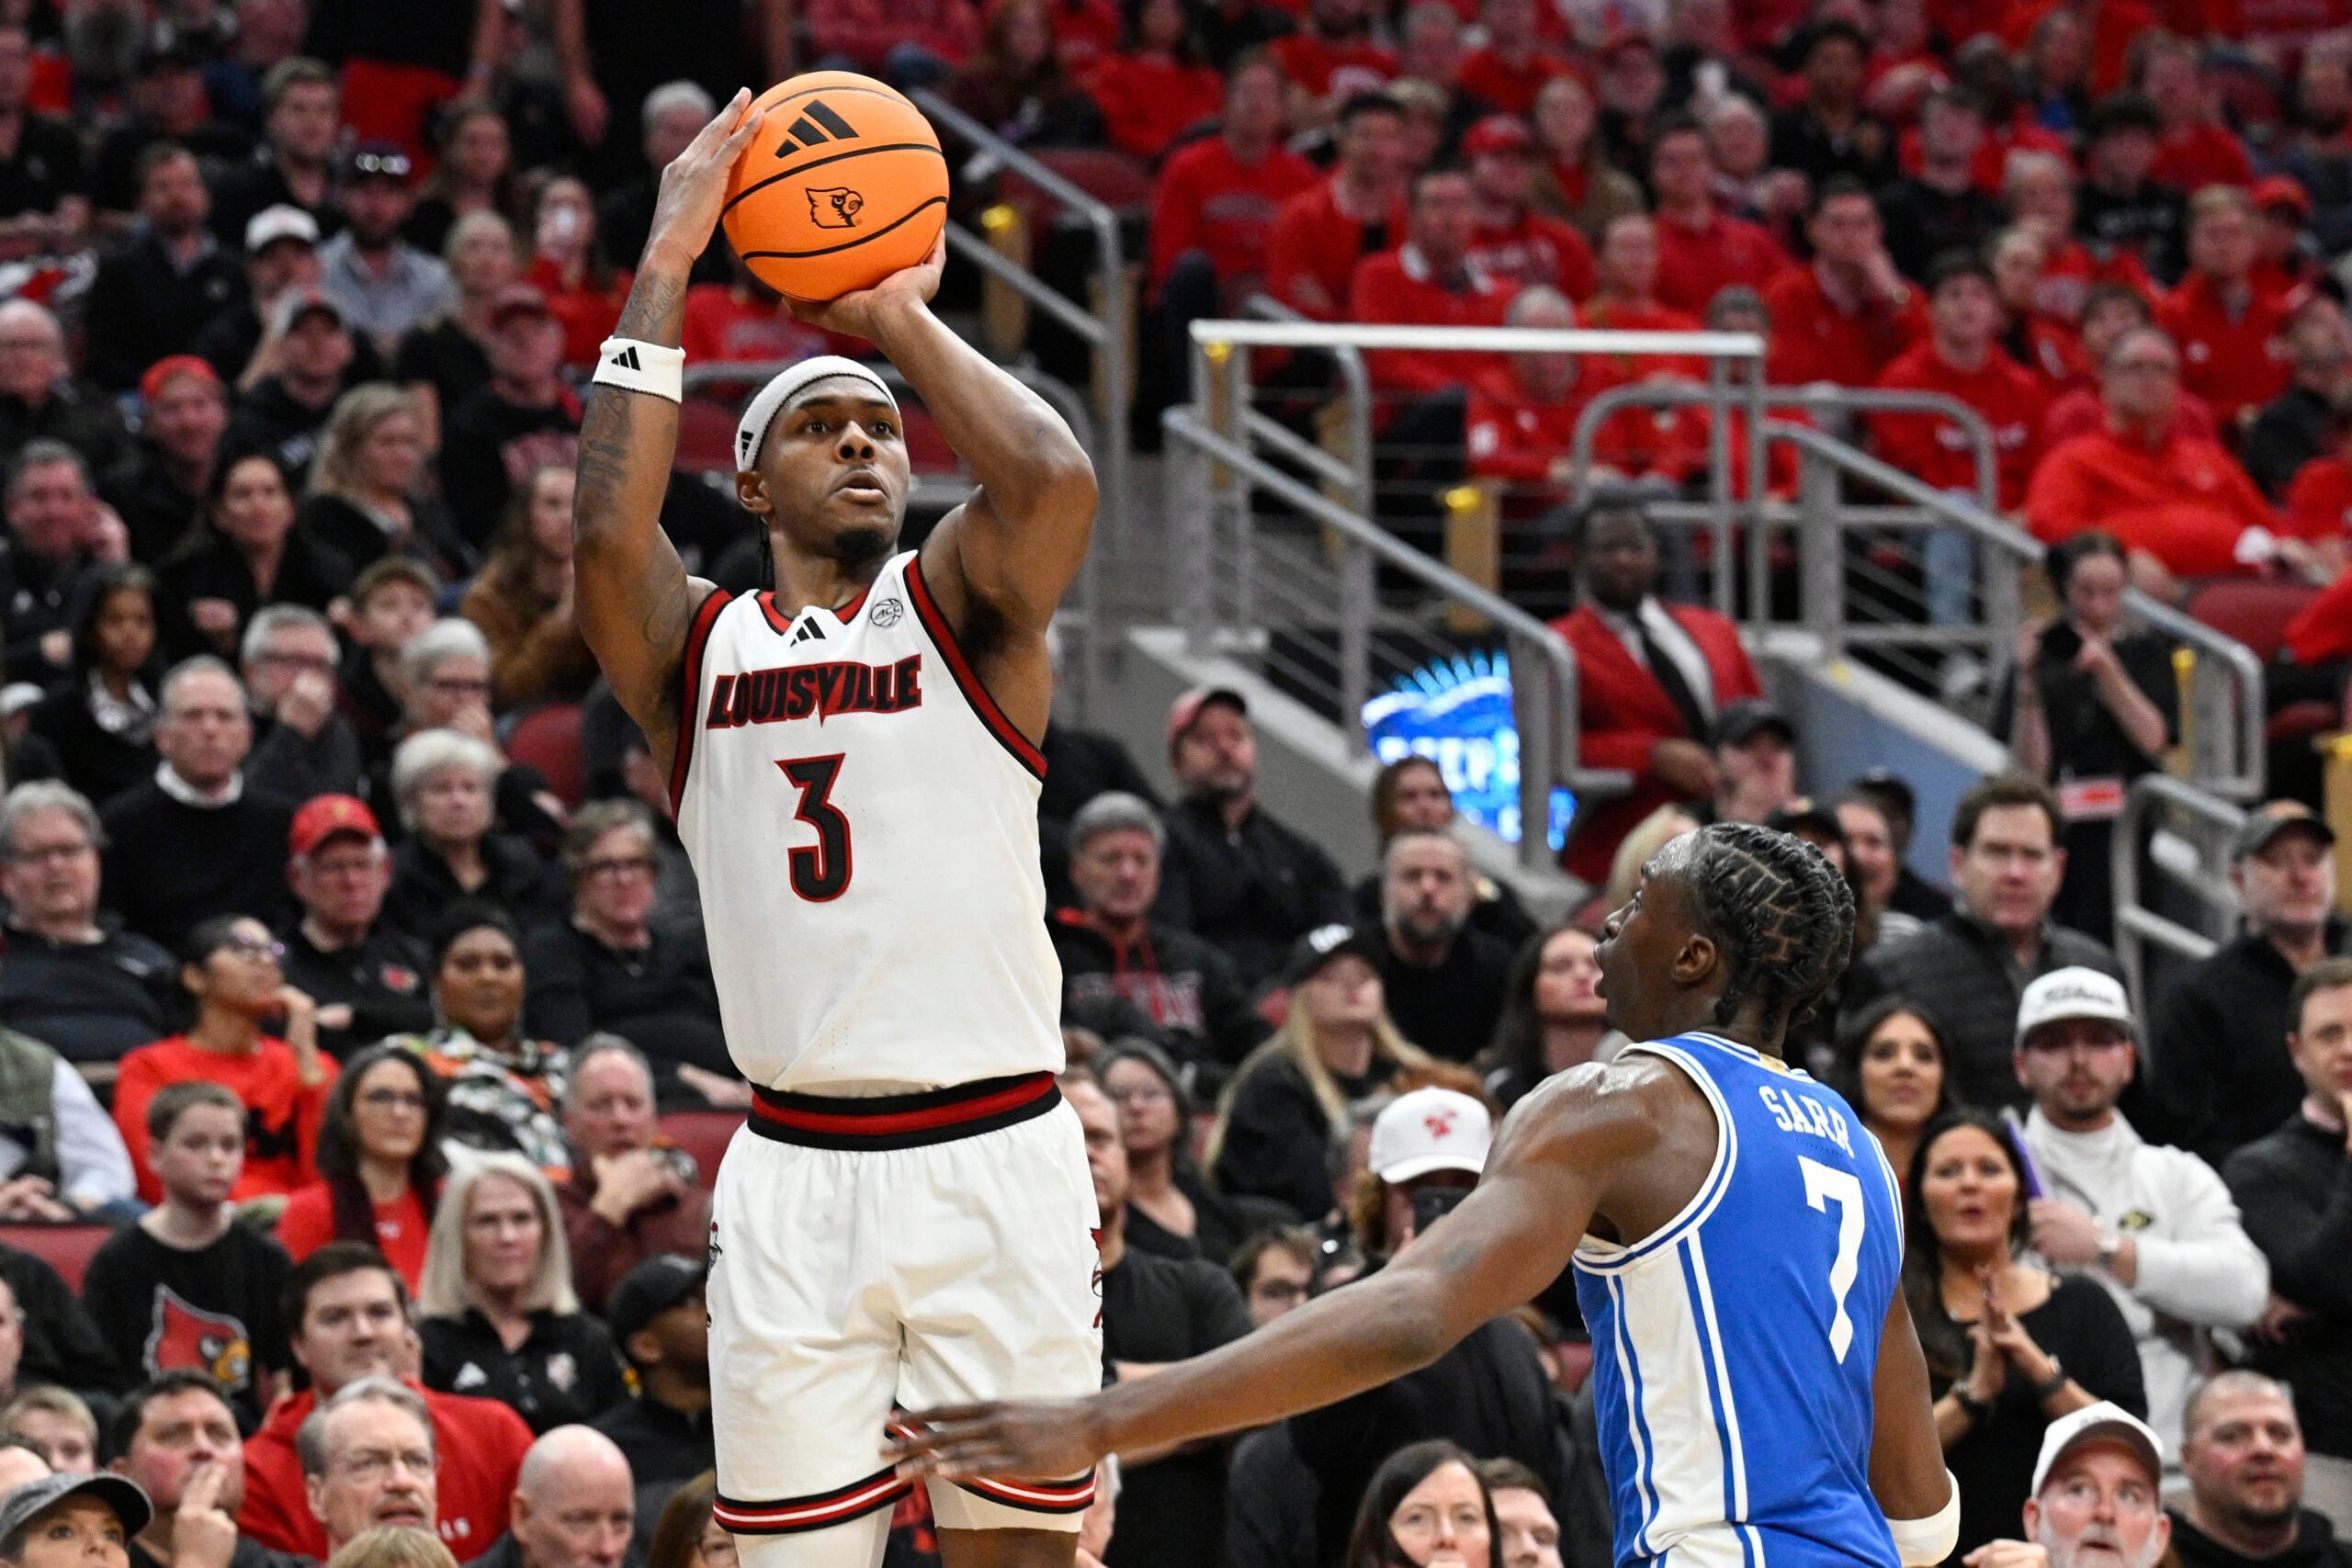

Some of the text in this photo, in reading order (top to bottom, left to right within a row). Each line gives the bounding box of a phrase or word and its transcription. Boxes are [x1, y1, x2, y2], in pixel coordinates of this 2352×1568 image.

[875, 606, 901, 620] ACC
[707, 654, 922, 729] LOUISVILLE
[775, 752, 853, 903] 3
[1758, 1086, 1855, 1158] SARR
[1798, 1155, 1865, 1365] 7
